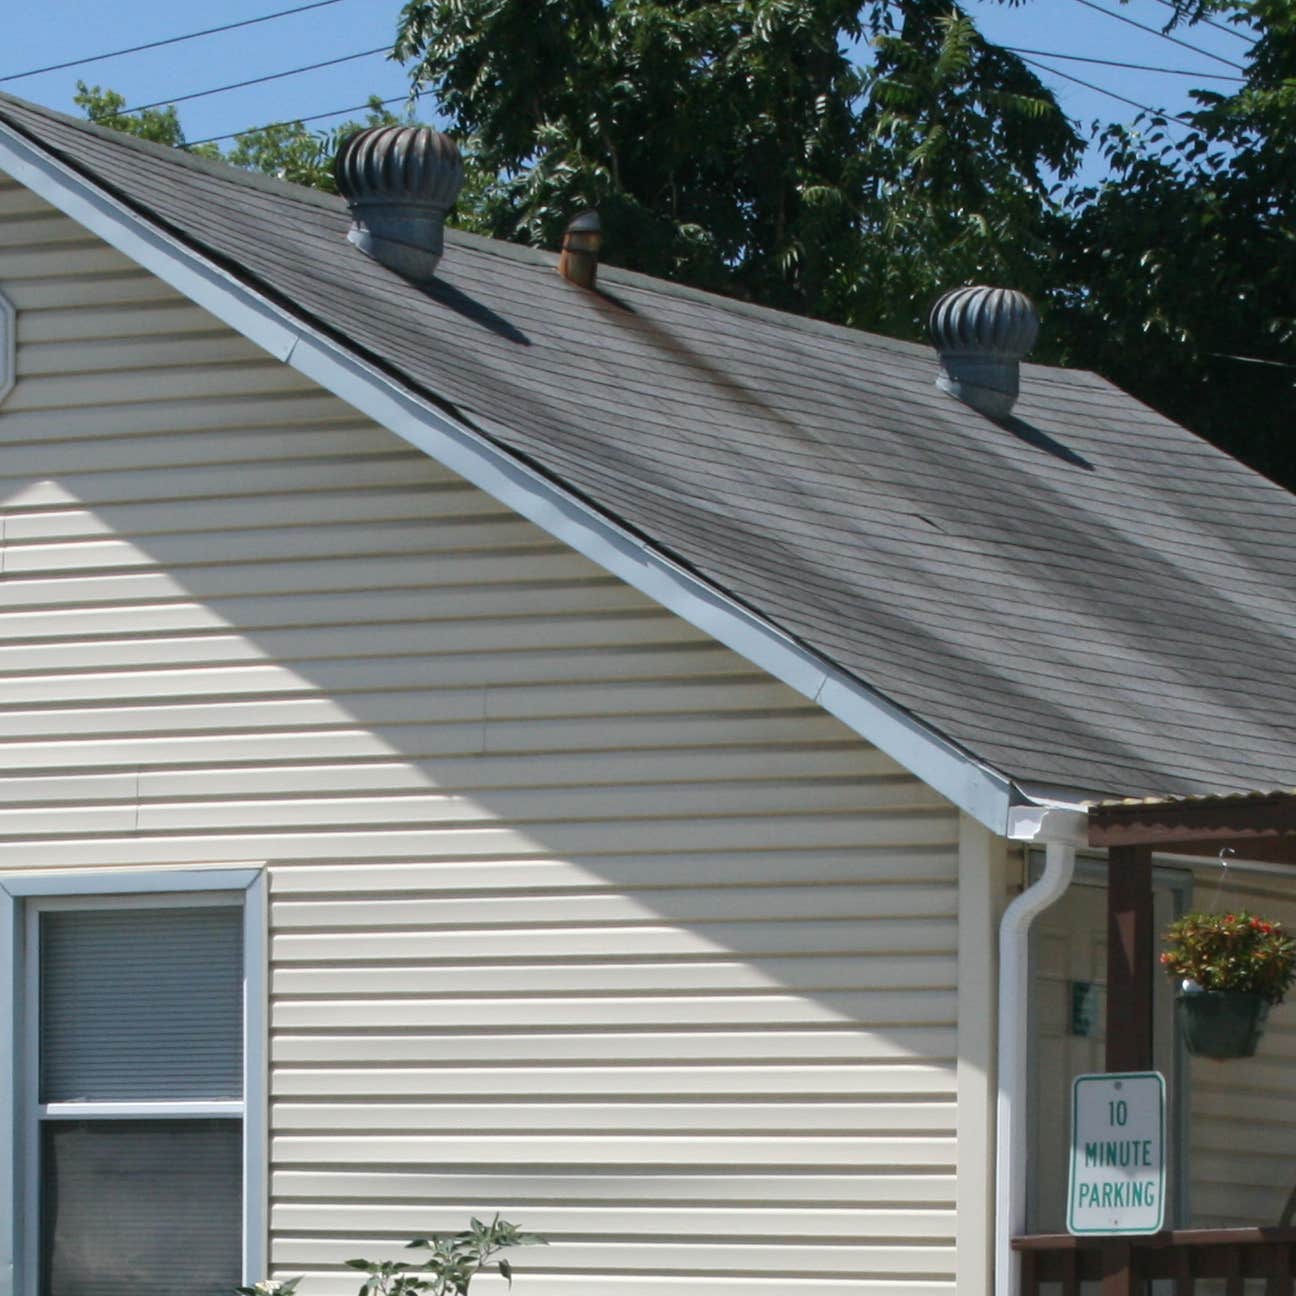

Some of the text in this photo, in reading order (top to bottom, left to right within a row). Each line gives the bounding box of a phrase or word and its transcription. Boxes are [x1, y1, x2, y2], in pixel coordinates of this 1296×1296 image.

[1108, 1100, 1128, 1126] 10
[1084, 1140, 1153, 1168] MINUTE
[1078, 1181, 1155, 1208] PARKING
